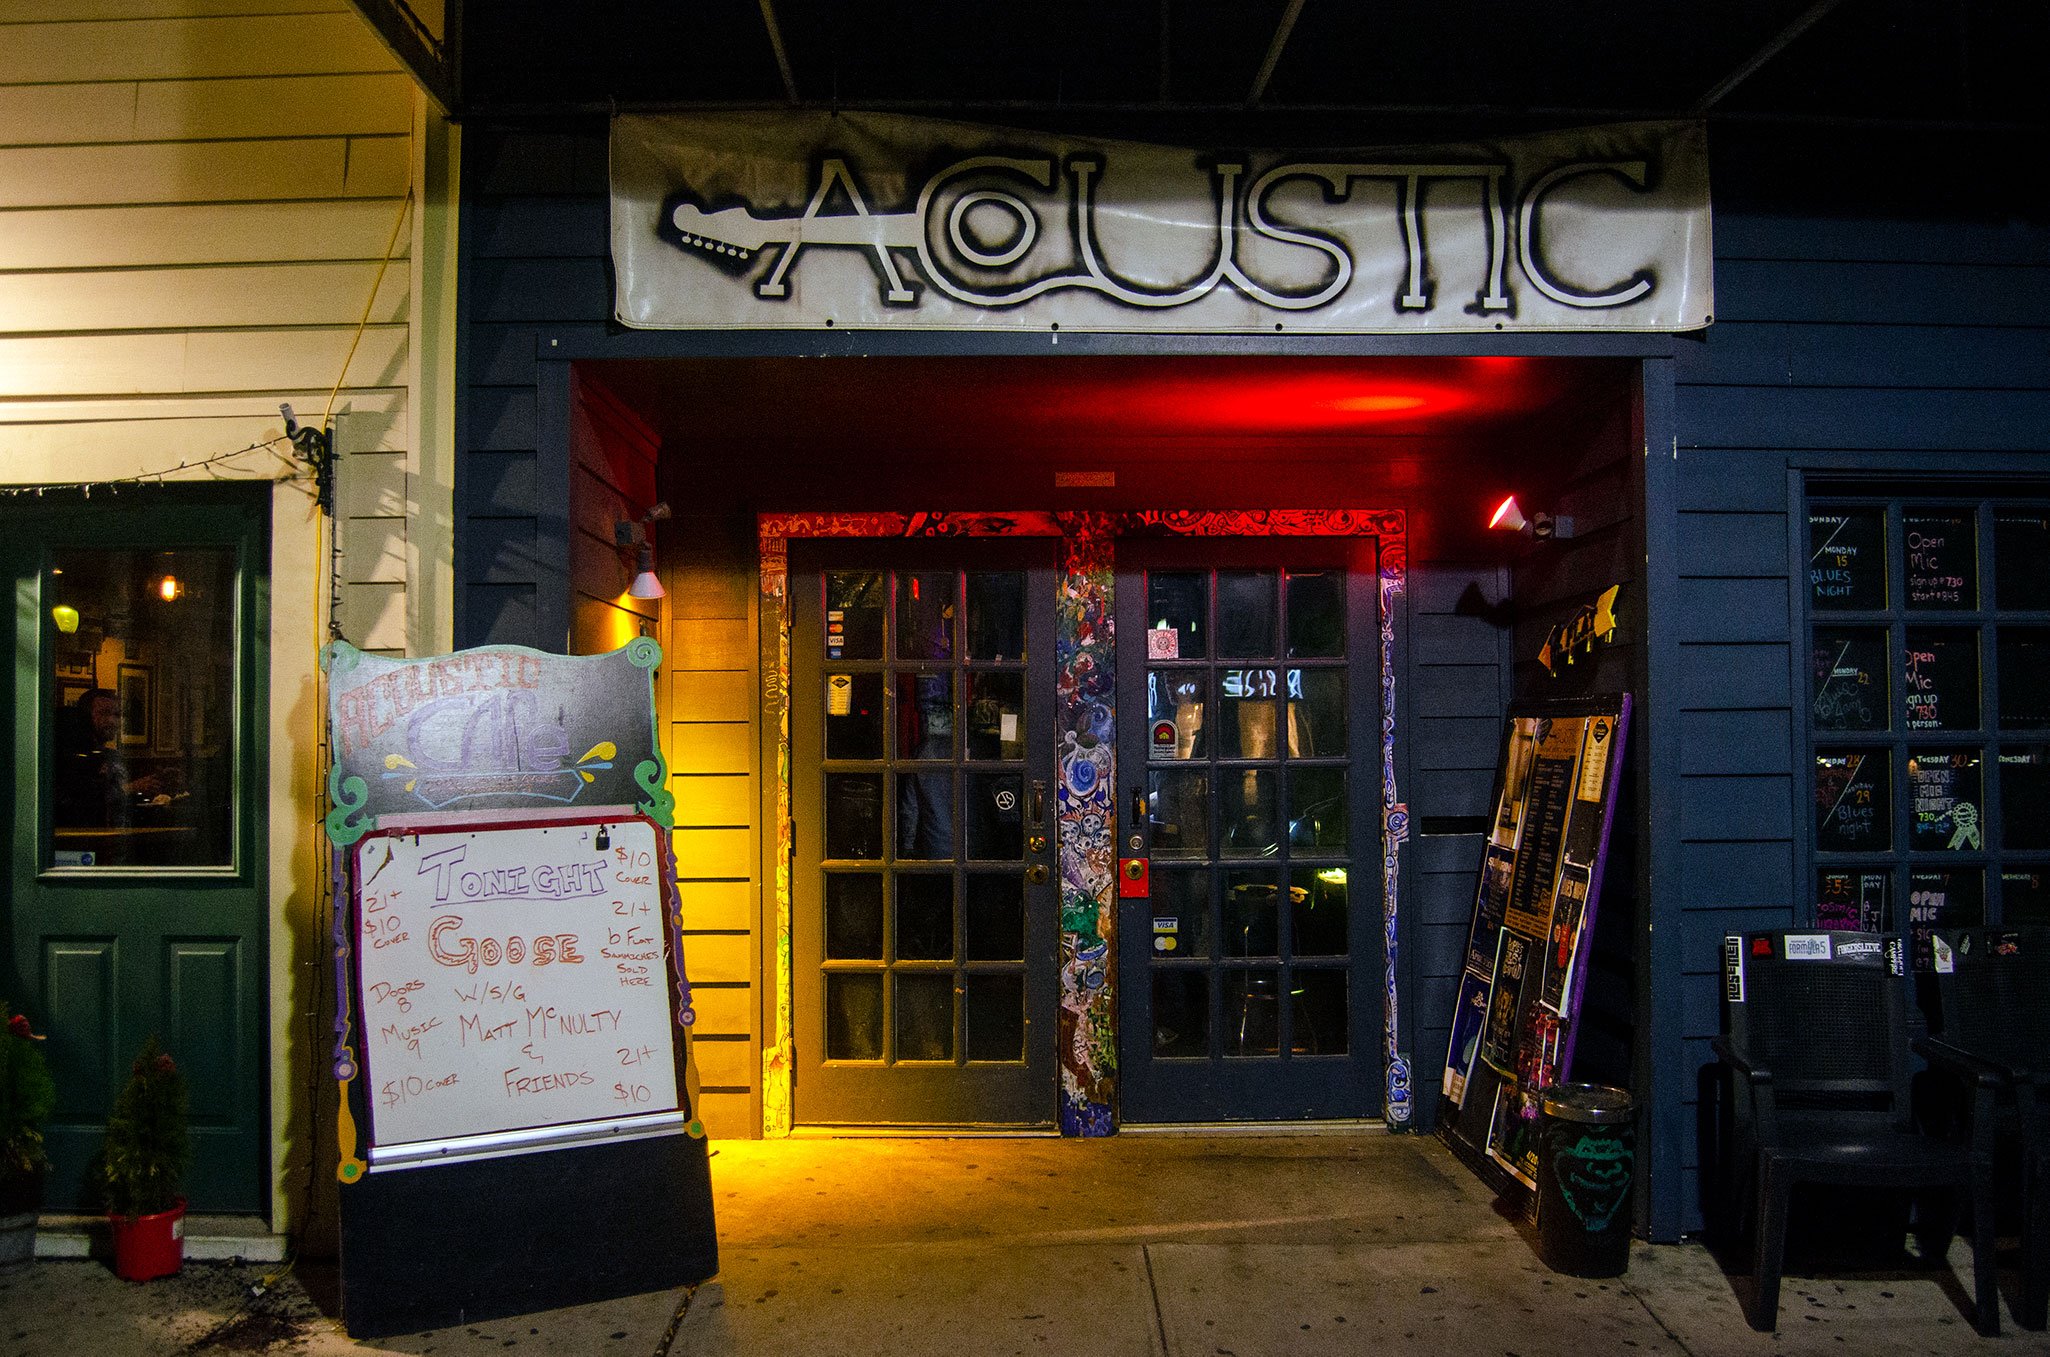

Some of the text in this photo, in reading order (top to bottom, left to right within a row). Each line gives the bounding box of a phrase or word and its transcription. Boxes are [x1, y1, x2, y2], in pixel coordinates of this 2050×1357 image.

[1825, 546, 1857, 556] MONDAY
[1908, 532, 1945, 554] Open
[1836, 556, 1848, 567] 15
[1910, 552, 1938, 571] Mic
[1810, 569, 1851, 585] BLUES
[1945, 576, 1963, 588] 730
[1816, 585, 1854, 597] NIGHT
[1857, 671, 1871, 685] 22
[339, 651, 542, 759] ACOUSTIC
[1923, 693, 1938, 708] up
[1916, 705, 1938, 720] 730
[1916, 754, 1950, 764] TUESDAY
[1917, 769, 1951, 784] OPEN
[1855, 789, 1872, 805] 29
[1838, 804, 1874, 821] Blues
[1918, 812, 1935, 822] 730
[615, 846, 651, 869] $10
[417, 843, 608, 901] TONIGHT
[616, 872, 653, 885] COVER
[366, 890, 402, 914] 21+
[612, 901, 651, 917] 21+
[1909, 907, 1937, 923] MIC
[364, 915, 401, 939] $10
[374, 931, 411, 949] COVER
[428, 915, 585, 975] GOOSE
[617, 963, 649, 975] SOLD
[619, 976, 654, 987] HERE
[370, 979, 426, 1004] DOORS
[397, 997, 412, 1014] 8
[381, 1017, 443, 1045] MUSIC
[459, 1014, 518, 1048] MATT
[407, 1038, 422, 1060] 9
[616, 1045, 659, 1066] 21+
[504, 1066, 595, 1098] FRIENDS
[382, 1075, 423, 1109] $10
[614, 1081, 651, 1107] $10
